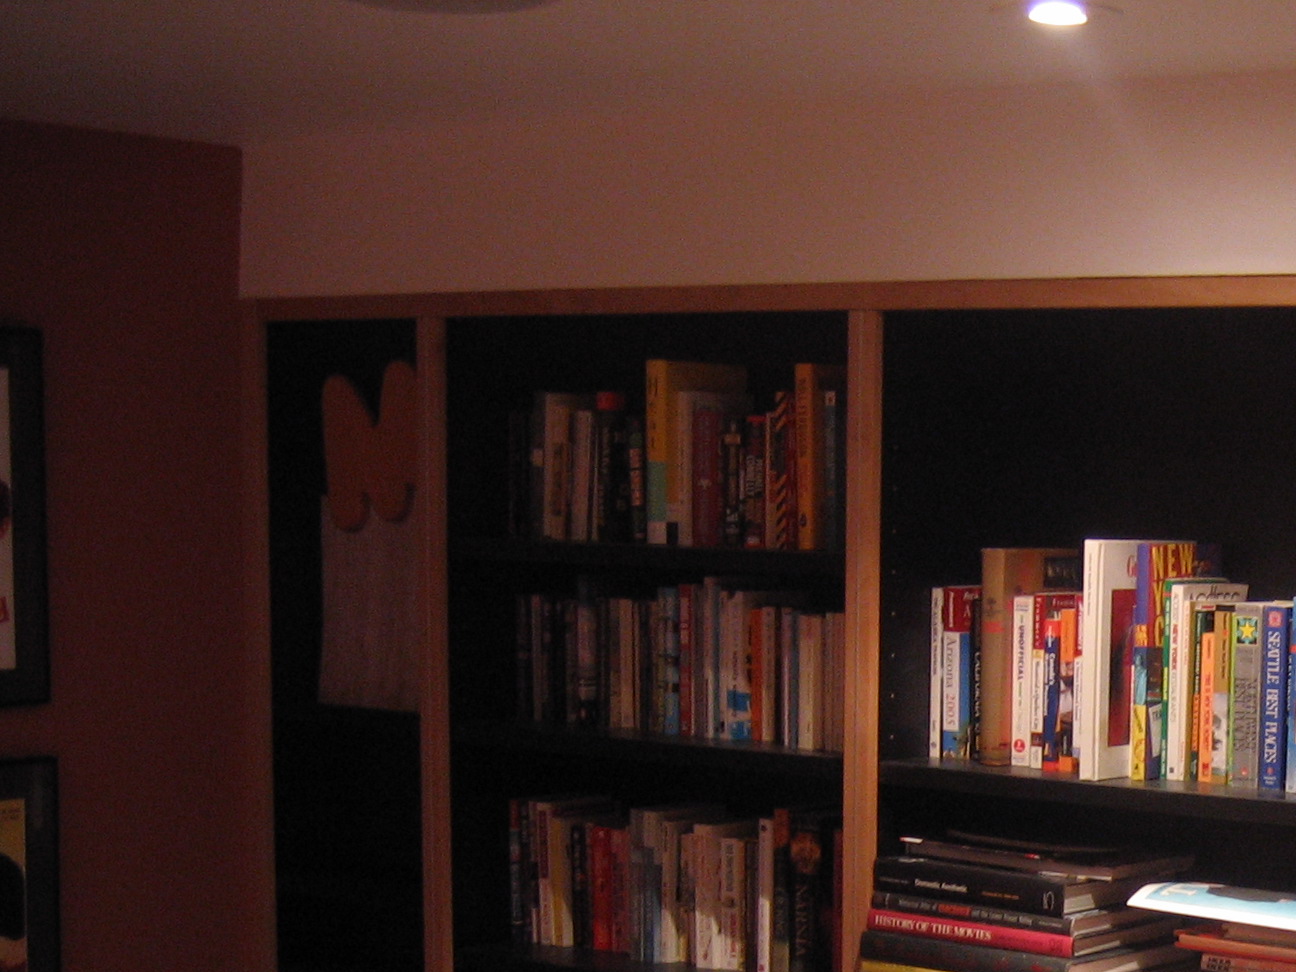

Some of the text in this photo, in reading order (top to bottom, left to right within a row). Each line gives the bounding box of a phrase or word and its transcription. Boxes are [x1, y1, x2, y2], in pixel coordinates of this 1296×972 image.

[1151, 543, 1194, 579] NEW
[1171, 624, 1179, 645] NEW
[1171, 648, 1179, 671] YORK
[945, 636, 959, 727] Arizona 2005
[1263, 631, 1281, 763] SEATTLE BEST PLACES
[875, 914, 992, 941] HISTORY OF THE MOVIES
